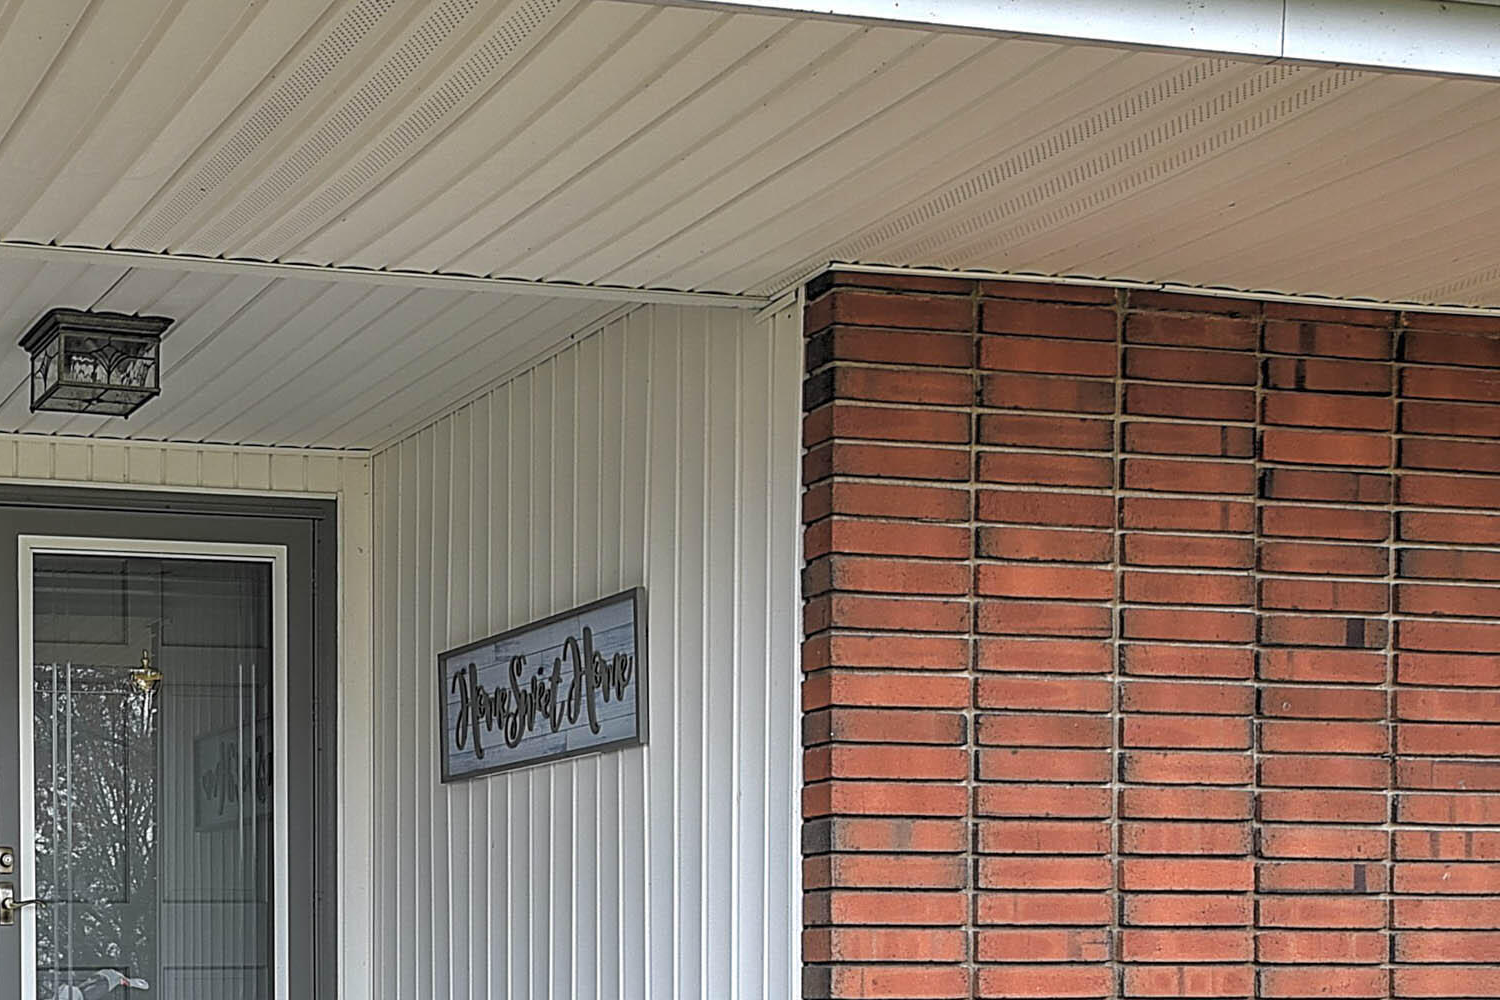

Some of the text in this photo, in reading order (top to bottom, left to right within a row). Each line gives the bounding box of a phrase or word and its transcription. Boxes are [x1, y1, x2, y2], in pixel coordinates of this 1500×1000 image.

[451, 626, 633, 760] Home Sweet Home
